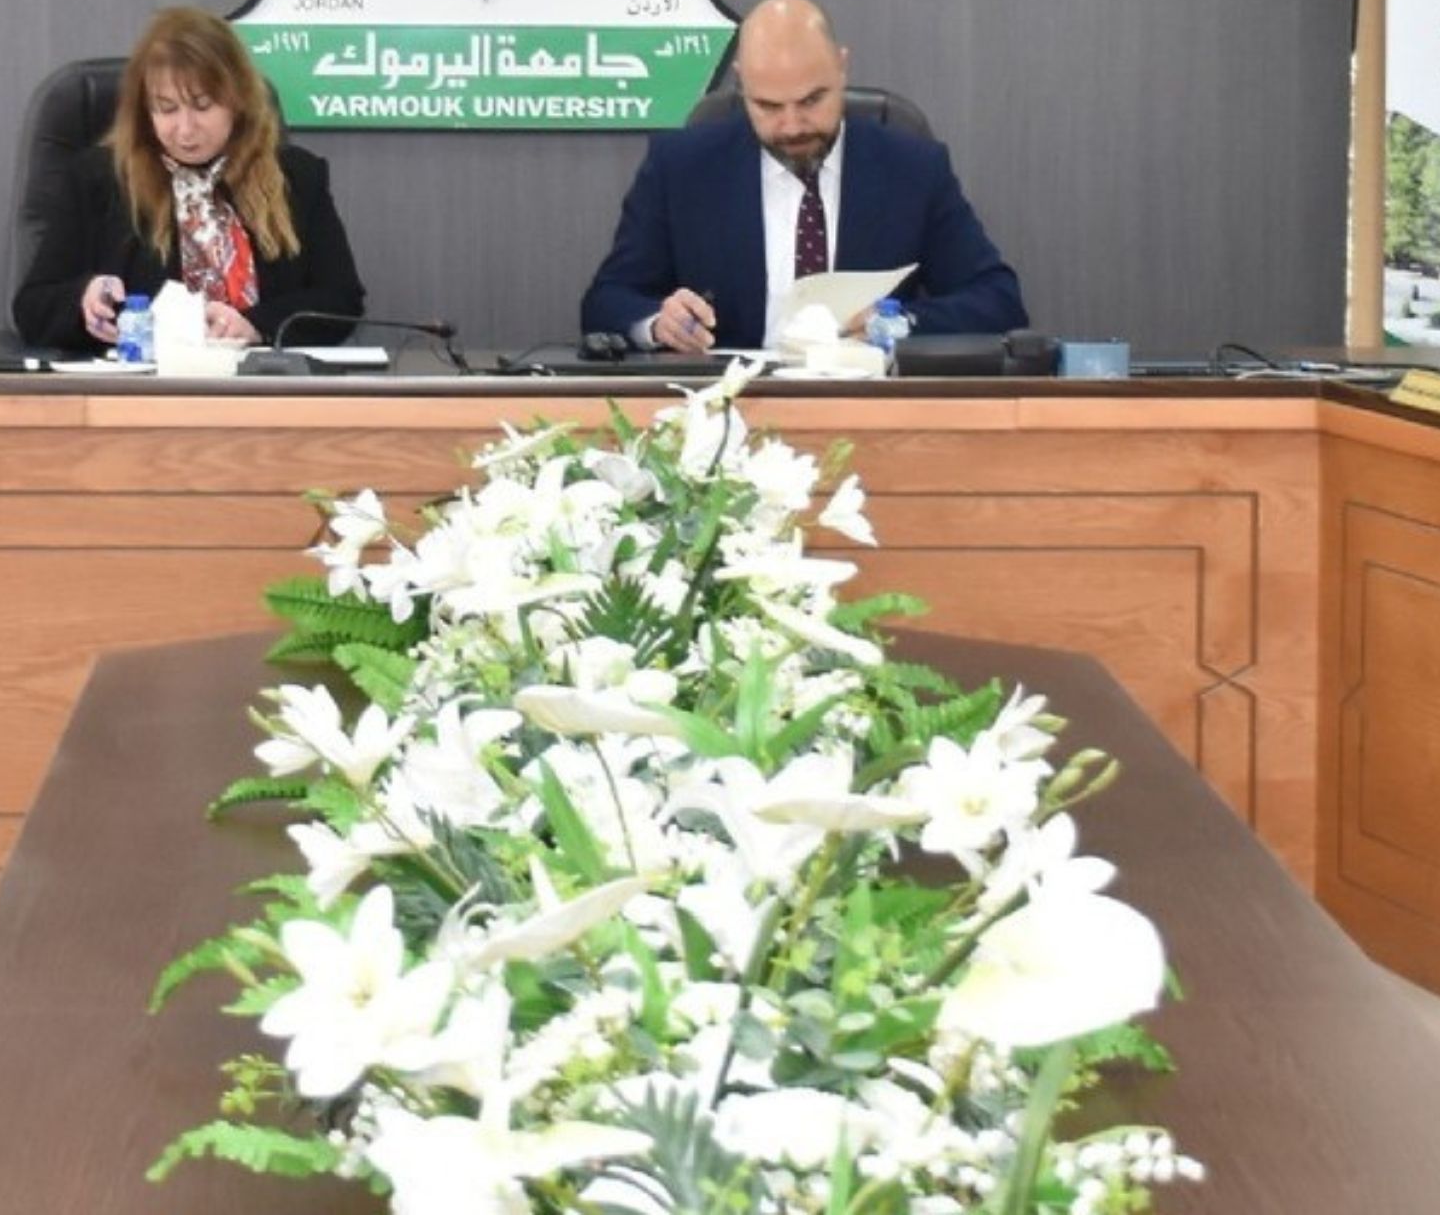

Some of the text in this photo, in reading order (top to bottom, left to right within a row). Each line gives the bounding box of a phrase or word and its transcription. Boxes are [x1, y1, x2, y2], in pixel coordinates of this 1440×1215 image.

[313, 31, 649, 90] جامعة اليرموك
[311, 95, 653, 118] YARMOUK UNIVERSITY
